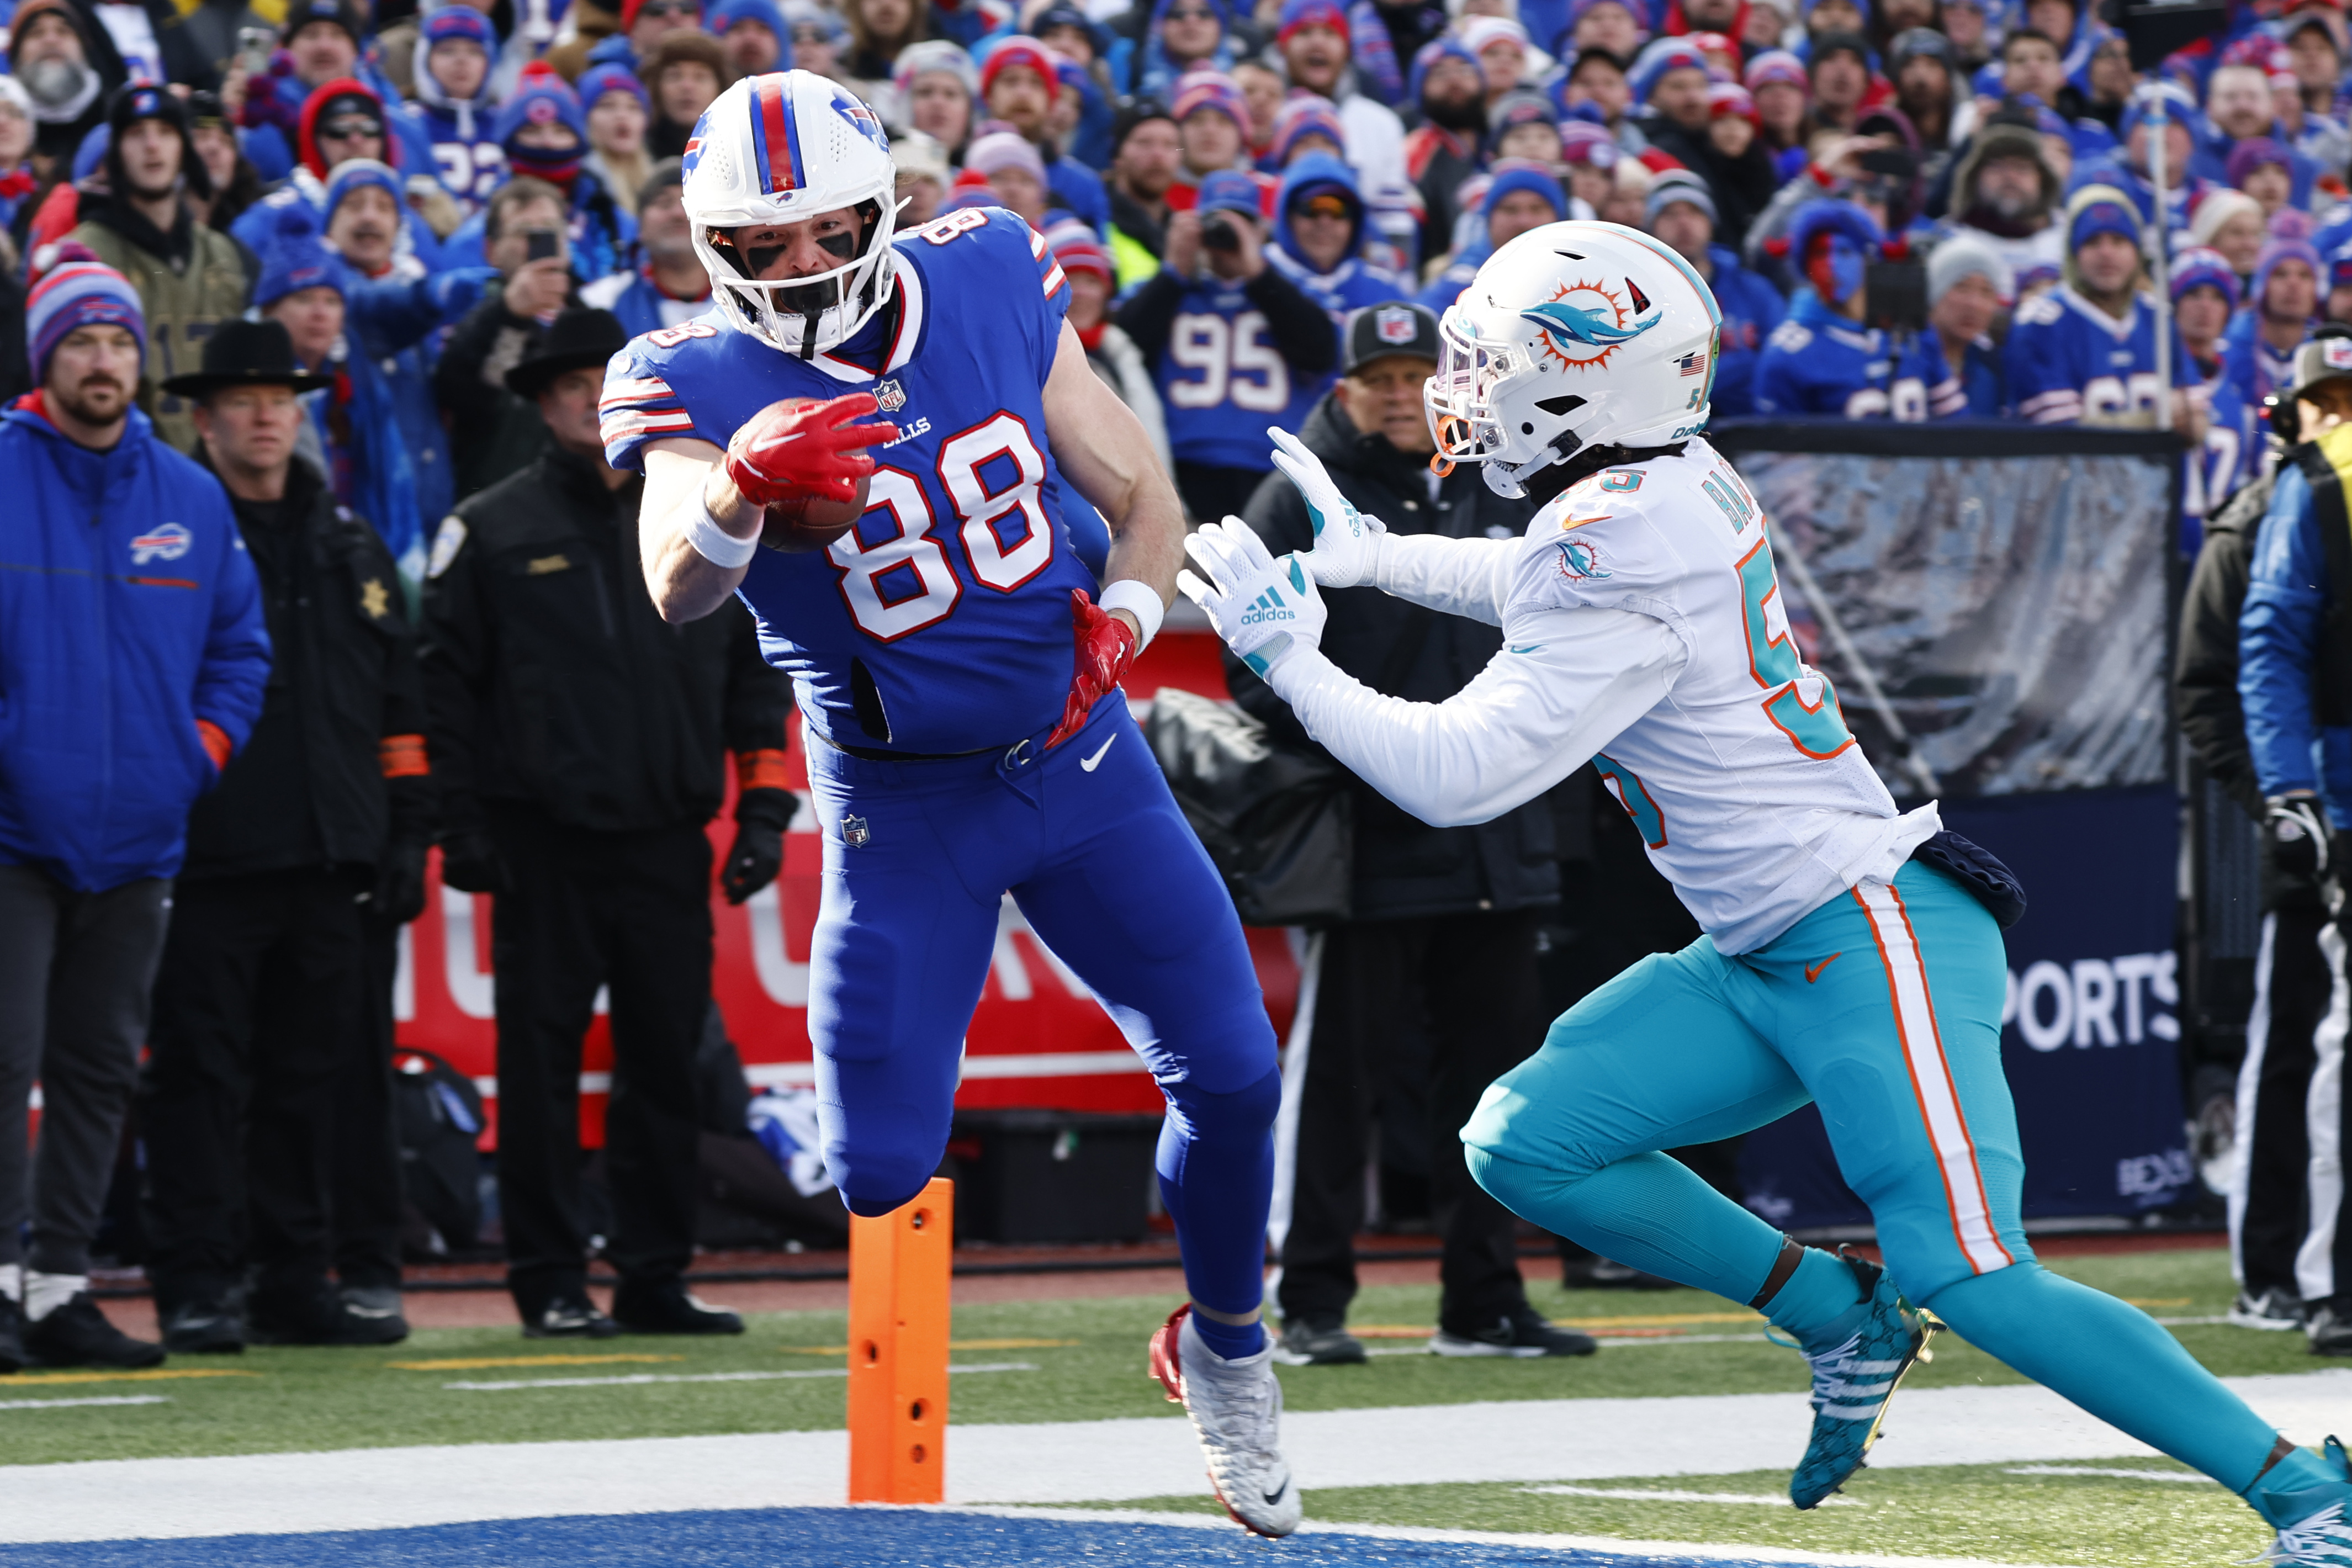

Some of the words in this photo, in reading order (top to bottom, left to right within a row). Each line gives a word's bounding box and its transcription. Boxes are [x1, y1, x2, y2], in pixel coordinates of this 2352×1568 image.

[1167, 310, 1291, 413] 95
[881, 391, 902, 407] NFL
[883, 416, 931, 449] LLS
[824, 407, 1055, 645] 88
[1241, 607, 1296, 626] adidas
